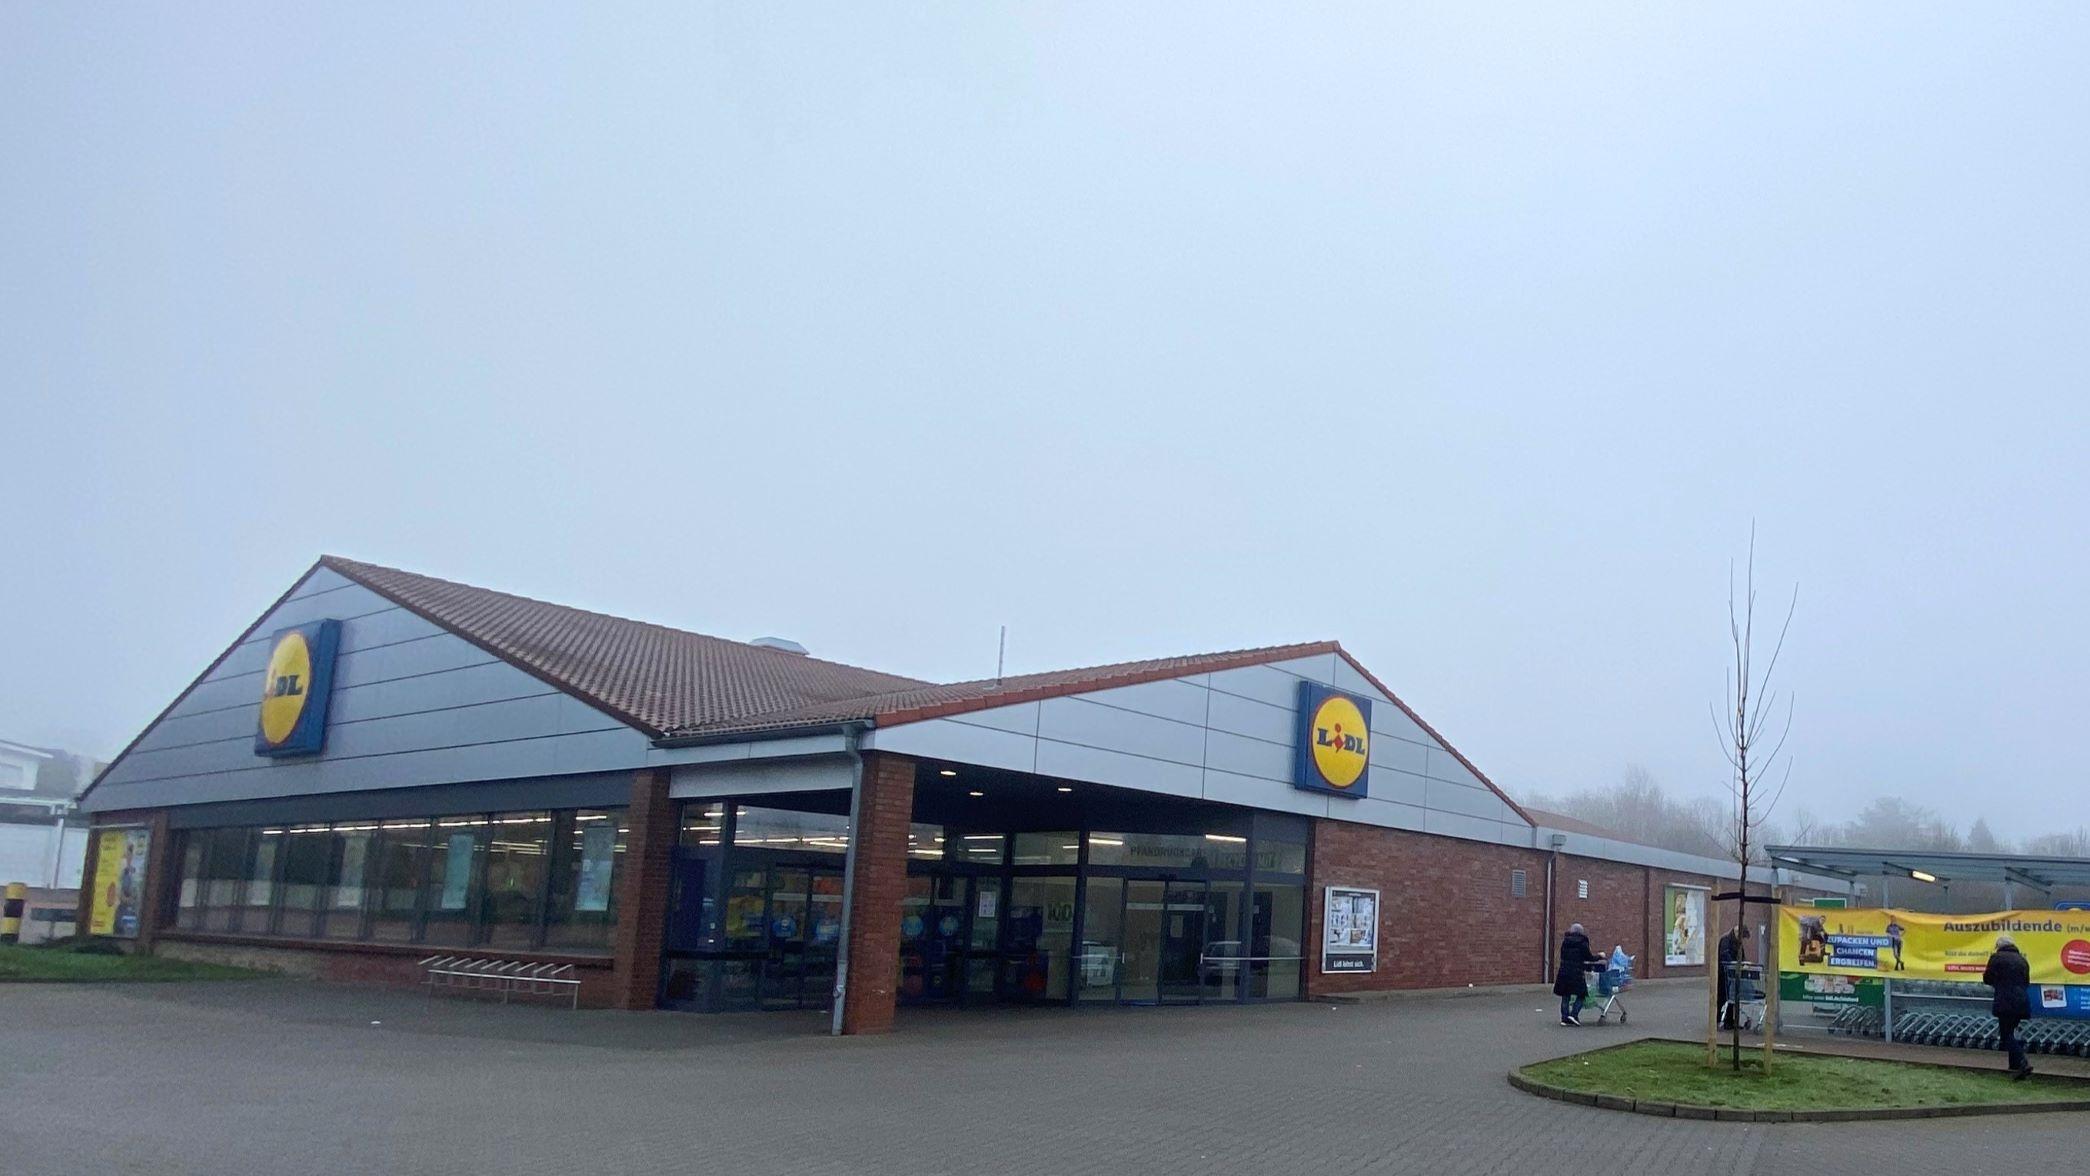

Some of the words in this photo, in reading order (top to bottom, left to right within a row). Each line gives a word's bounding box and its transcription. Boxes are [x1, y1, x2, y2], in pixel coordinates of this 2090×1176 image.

[1944, 920, 2062, 932] Auszubildende
[1827, 935, 1868, 945] ZUPACKEN
[1870, 938, 1889, 946] UND
[1836, 947, 1874, 956] CHANCEN
